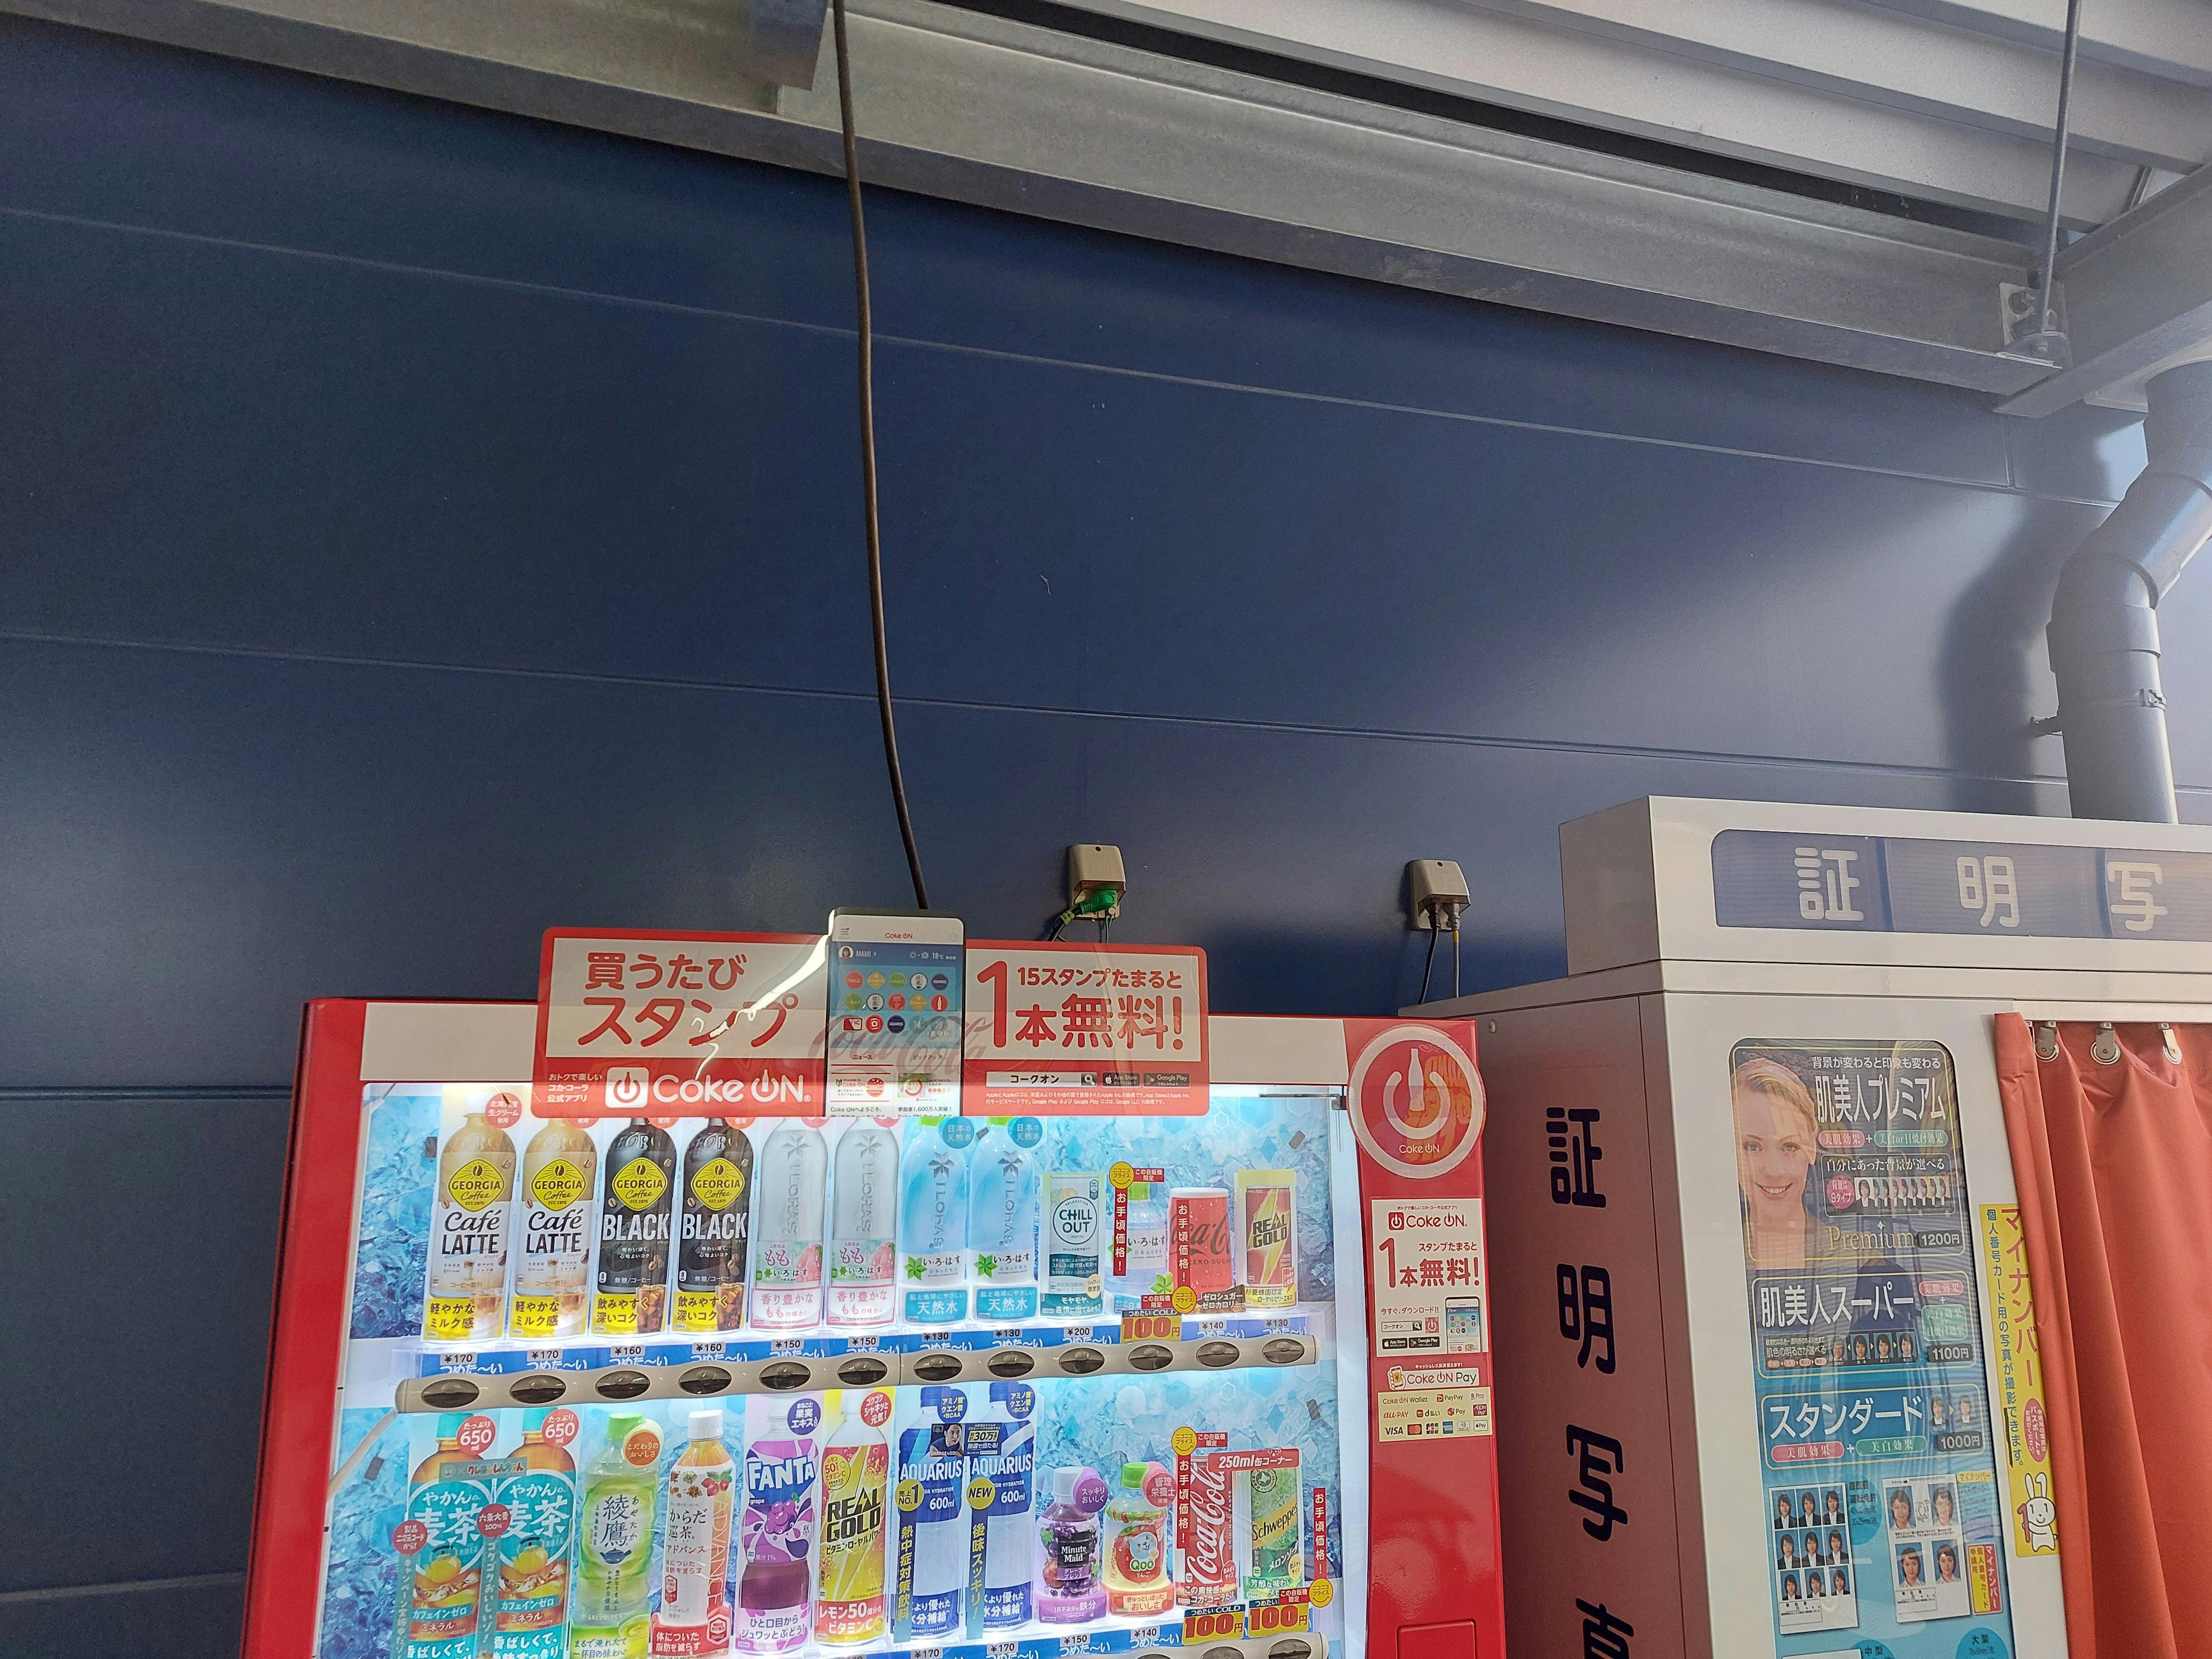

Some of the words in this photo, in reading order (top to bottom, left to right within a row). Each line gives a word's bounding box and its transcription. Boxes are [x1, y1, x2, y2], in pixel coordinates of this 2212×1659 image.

[585, 951, 747, 990] 買うたび
[1018, 967, 1182, 989] 15スタンプたまると
[977, 961, 1007, 1048] 1
[578, 993, 798, 1048] スタンプ
[1015, 993, 1184, 1050] 本無料!
[1812, 1057, 1940, 1069] 背景が変わると印象も変わる
[1010, 1074, 1060, 1084] コークオン
[653, 1073, 744, 1103] Coke
[546, 1095, 587, 1103] 公式アプリ
[1815, 1074, 1946, 1123] 肌美人プレミアム
[487, 1108, 519, 1117] 生クリーム
[1399, 1144, 1424, 1153] Coke
[1826, 1158, 1945, 1172] 自分にあった背景が選べる
[452, 1181, 501, 1190] GEORGIA
[1832, 1181, 1848, 1190] 背景は
[461, 1191, 490, 1201] Coffee
[1831, 1194, 1851, 1203] 9タイプ
[444, 1209, 500, 1232] Café
[529, 1208, 584, 1232] Café
[1059, 1209, 1093, 1220] CHILL
[602, 1213, 670, 1240] BLACK
[682, 1213, 747, 1239] BLACK
[1062, 1222, 1090, 1233] OUT
[1253, 1212, 1286, 1235] REAL
[1406, 1215, 1441, 1228] Coke
[1115, 1193, 1126, 1271] お手頃価格!
[1253, 1227, 1288, 1248] GOLD
[1829, 1226, 1916, 1251] Premium
[442, 1234, 498, 1254] LATTE
[1178, 1205, 1189, 1282] お手頃価格!
[1922, 1233, 1960, 1246] 1200円
[1419, 1242, 1477, 1251] スタンプたまると
[764, 1250, 789, 1266] もも
[1379, 1238, 1395, 1287] 1
[1400, 1257, 1480, 1287] 本無料!
[597, 1297, 648, 1310] 飲みやすく
[761, 1293, 813, 1305] 香り豊かな
[909, 1293, 964, 1301] 私と地球にやさしい
[1203, 1293, 1243, 1301] ゼロシュガー
[2002, 1209, 2038, 1386] マイナンバー
[430, 1303, 476, 1314] 軽やかな
[1761, 1281, 1914, 1327] 肌美人スーパー
[430, 1317, 475, 1328] ミルク感
[597, 1313, 638, 1324] 深いコク
[1123, 1317, 1180, 1339] 100円
[924, 1332, 949, 1340] ¥130
[776, 1340, 800, 1348] ¥150
[1767, 1346, 1826, 1357] 肌色の明るさが選べる
[1933, 1347, 1969, 1360] 1100円
[1407, 1374, 1435, 1384] Coke
[1456, 1372, 1476, 1384] Pay
[796, 1409, 813, 1418] 果実
[864, 1401, 889, 1417] シャキッと
[871, 1411, 887, 1425] 元気!
[1770, 1395, 1923, 1439] スタンダード
[1384, 1427, 1403, 1435] VISA
[1426, 1423, 1438, 1434] JCB
[460, 1430, 492, 1445] 650
[1941, 1435, 1980, 1449] 1000円
[627, 1442, 658, 1450] こだわりの
[1788, 1446, 1830, 1458] 美肌効果
[1872, 1439, 1913, 1452] 美白効果
[972, 1453, 1032, 1477] AQUARIUS
[1218, 1454, 1293, 1469] 250ml缶コーナー
[747, 1456, 814, 1491] FANTA
[826, 1471, 846, 1481] ビタミンC
[900, 1460, 962, 1481] AQUARIUS
[1155, 1478, 1172, 1486] 管理
[968, 1487, 993, 1498] NEW
[1082, 1487, 1105, 1495] スッキリ
[827, 1487, 881, 1523] REAL
[929, 1497, 954, 1510] 600ml
[1082, 1495, 1104, 1504] おいしく
[479, 1512, 509, 1523] 六条大麦
[600, 1494, 630, 1548] 綾鷹
[1252, 1503, 1299, 1541] Schweppes
[827, 1506, 882, 1543] GOLD
[669, 1526, 691, 1539] 巡茶
[826, 1530, 881, 1555] ビタミンローヤルパワー
[707, 1500, 729, 1605] ADVANCE
[1061, 1545, 1087, 1554] Minute
[1064, 1554, 1084, 1563] Maid
[1268, 1540, 1299, 1573] メロンソーダ
[971, 1523, 985, 1619] 後味スッキリ!
[1131, 1559, 1154, 1571] Qoo
[897, 1525, 913, 1622] 熱中症対策飲料
[1250, 1579, 1292, 1588] 芳醇な味わい
[1127, 1594, 1164, 1602] ぎゅっとしぼった
[1054, 1601, 1096, 1612] 1日不足分の鉄分
[1191, 1608, 1214, 1616] つめたい
[413, 1608, 467, 1620] カフェインゼロ
[1250, 1605, 1307, 1631] 100円
[422, 1622, 454, 1631] ミネラル
[750, 1615, 798, 1628] ひと口目から
[829, 1618, 874, 1634] ビタミンC
[1185, 1613, 1243, 1638] 100円
[575, 1637, 627, 1648] まるで淹れたて
[656, 1631, 699, 1641] 体についた
